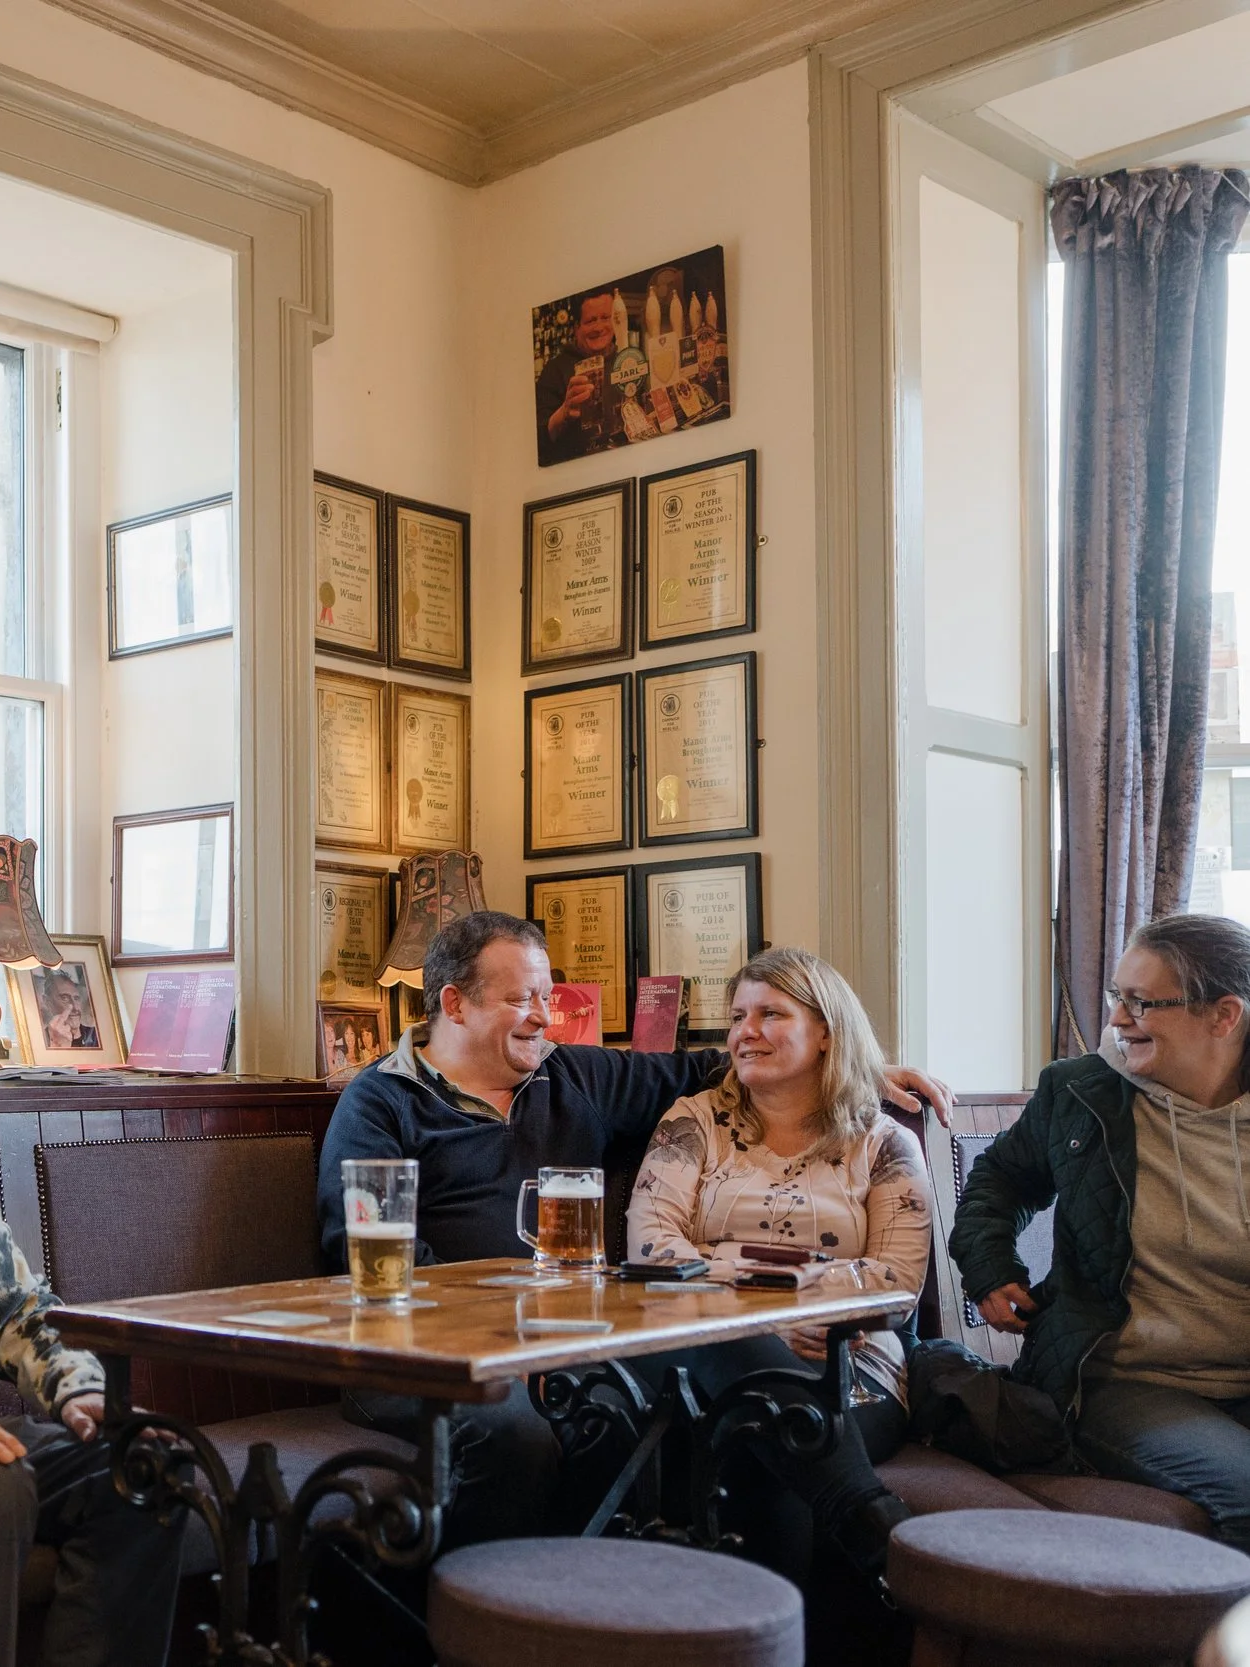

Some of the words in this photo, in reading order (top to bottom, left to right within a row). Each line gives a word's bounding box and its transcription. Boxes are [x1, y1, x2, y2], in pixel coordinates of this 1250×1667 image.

[619, 367, 640, 379] JARL
[701, 489, 717, 499] PUB
[695, 501, 706, 509] OF
[707, 497, 721, 507] THE
[694, 506, 723, 519] SEASON
[582, 521, 595, 530] PUB
[685, 517, 714, 530] WINTER
[716, 513, 732, 523] 2012
[577, 532, 585, 540] OF
[588, 528, 601, 537] THE
[576, 537, 602, 549] SEASON
[694, 537, 723, 550] Manor
[575, 546, 602, 558] WINTER
[696, 548, 719, 560] Arms
[690, 557, 726, 570] Broughton
[566, 580, 588, 591] Manor
[589, 576, 609, 585] Arms
[688, 573, 730, 587] Winner
[340, 588, 362, 602] Winner
[572, 605, 602, 618] Winner
[580, 711, 595, 719] PUB
[585, 719, 599, 728] THE
[683, 738, 707, 748] Manor
[577, 765, 598, 775] Arms
[686, 777, 729, 789] Winner
[568, 790, 606, 801] Winner
[427, 799, 448, 811] Winner
[696, 892, 715, 902] PUB
[716, 891, 729, 900] OF
[691, 905, 711, 914] THE
[711, 903, 735, 912] YEAR
[702, 916, 724, 925] 2018
[695, 932, 730, 942] Manor
[574, 944, 605, 953] Manor
[699, 945, 728, 955] Arms
[577, 954, 602, 963] Arms
[692, 975, 731, 985] Winne
